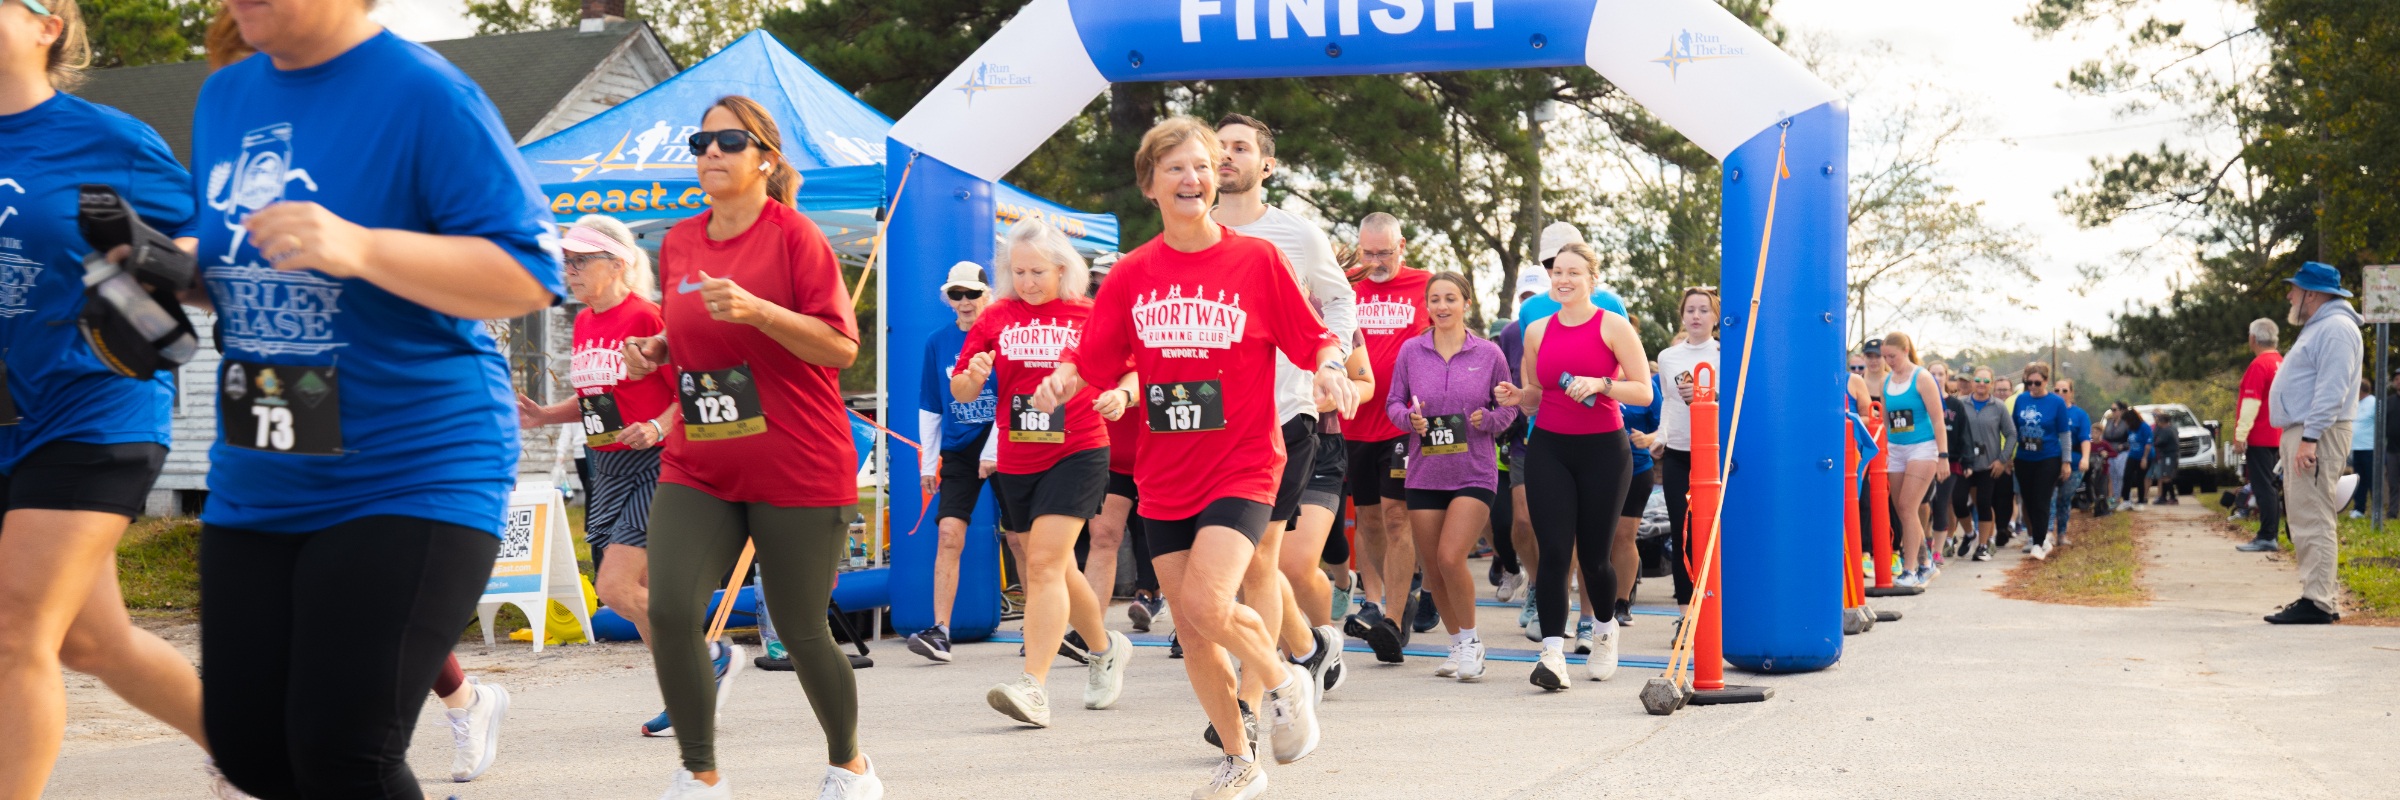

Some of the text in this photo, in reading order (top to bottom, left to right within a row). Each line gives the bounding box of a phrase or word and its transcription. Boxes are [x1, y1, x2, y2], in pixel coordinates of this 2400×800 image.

[1180, 0, 1495, 43] FINISH
[1695, 32, 1719, 43] Run
[1694, 44, 1744, 55] The East
[989, 63, 1010, 73] Run
[988, 74, 1032, 85] The East
[657, 145, 698, 162] Th
[546, 182, 713, 214] eeast.c
[207, 283, 343, 313] RLEY
[1135, 302, 1241, 335] SHORTWAY
[1356, 304, 1412, 320] HORTWAY
[223, 309, 334, 340] HASE
[1003, 328, 1070, 350] SHORTW
[1149, 331, 1224, 343] RUNNING CLUB
[1013, 347, 1049, 356] RUNNING
[1199, 349, 1209, 359] NC
[695, 395, 739, 424] 123
[951, 400, 997, 414] BARLE
[584, 414, 605, 435] 96
[1019, 411, 1050, 431] 168
[1165, 405, 1201, 430] 137
[1893, 417, 1907, 428] 120
[251, 405, 295, 451] 73
[1429, 428, 1454, 446] 125
